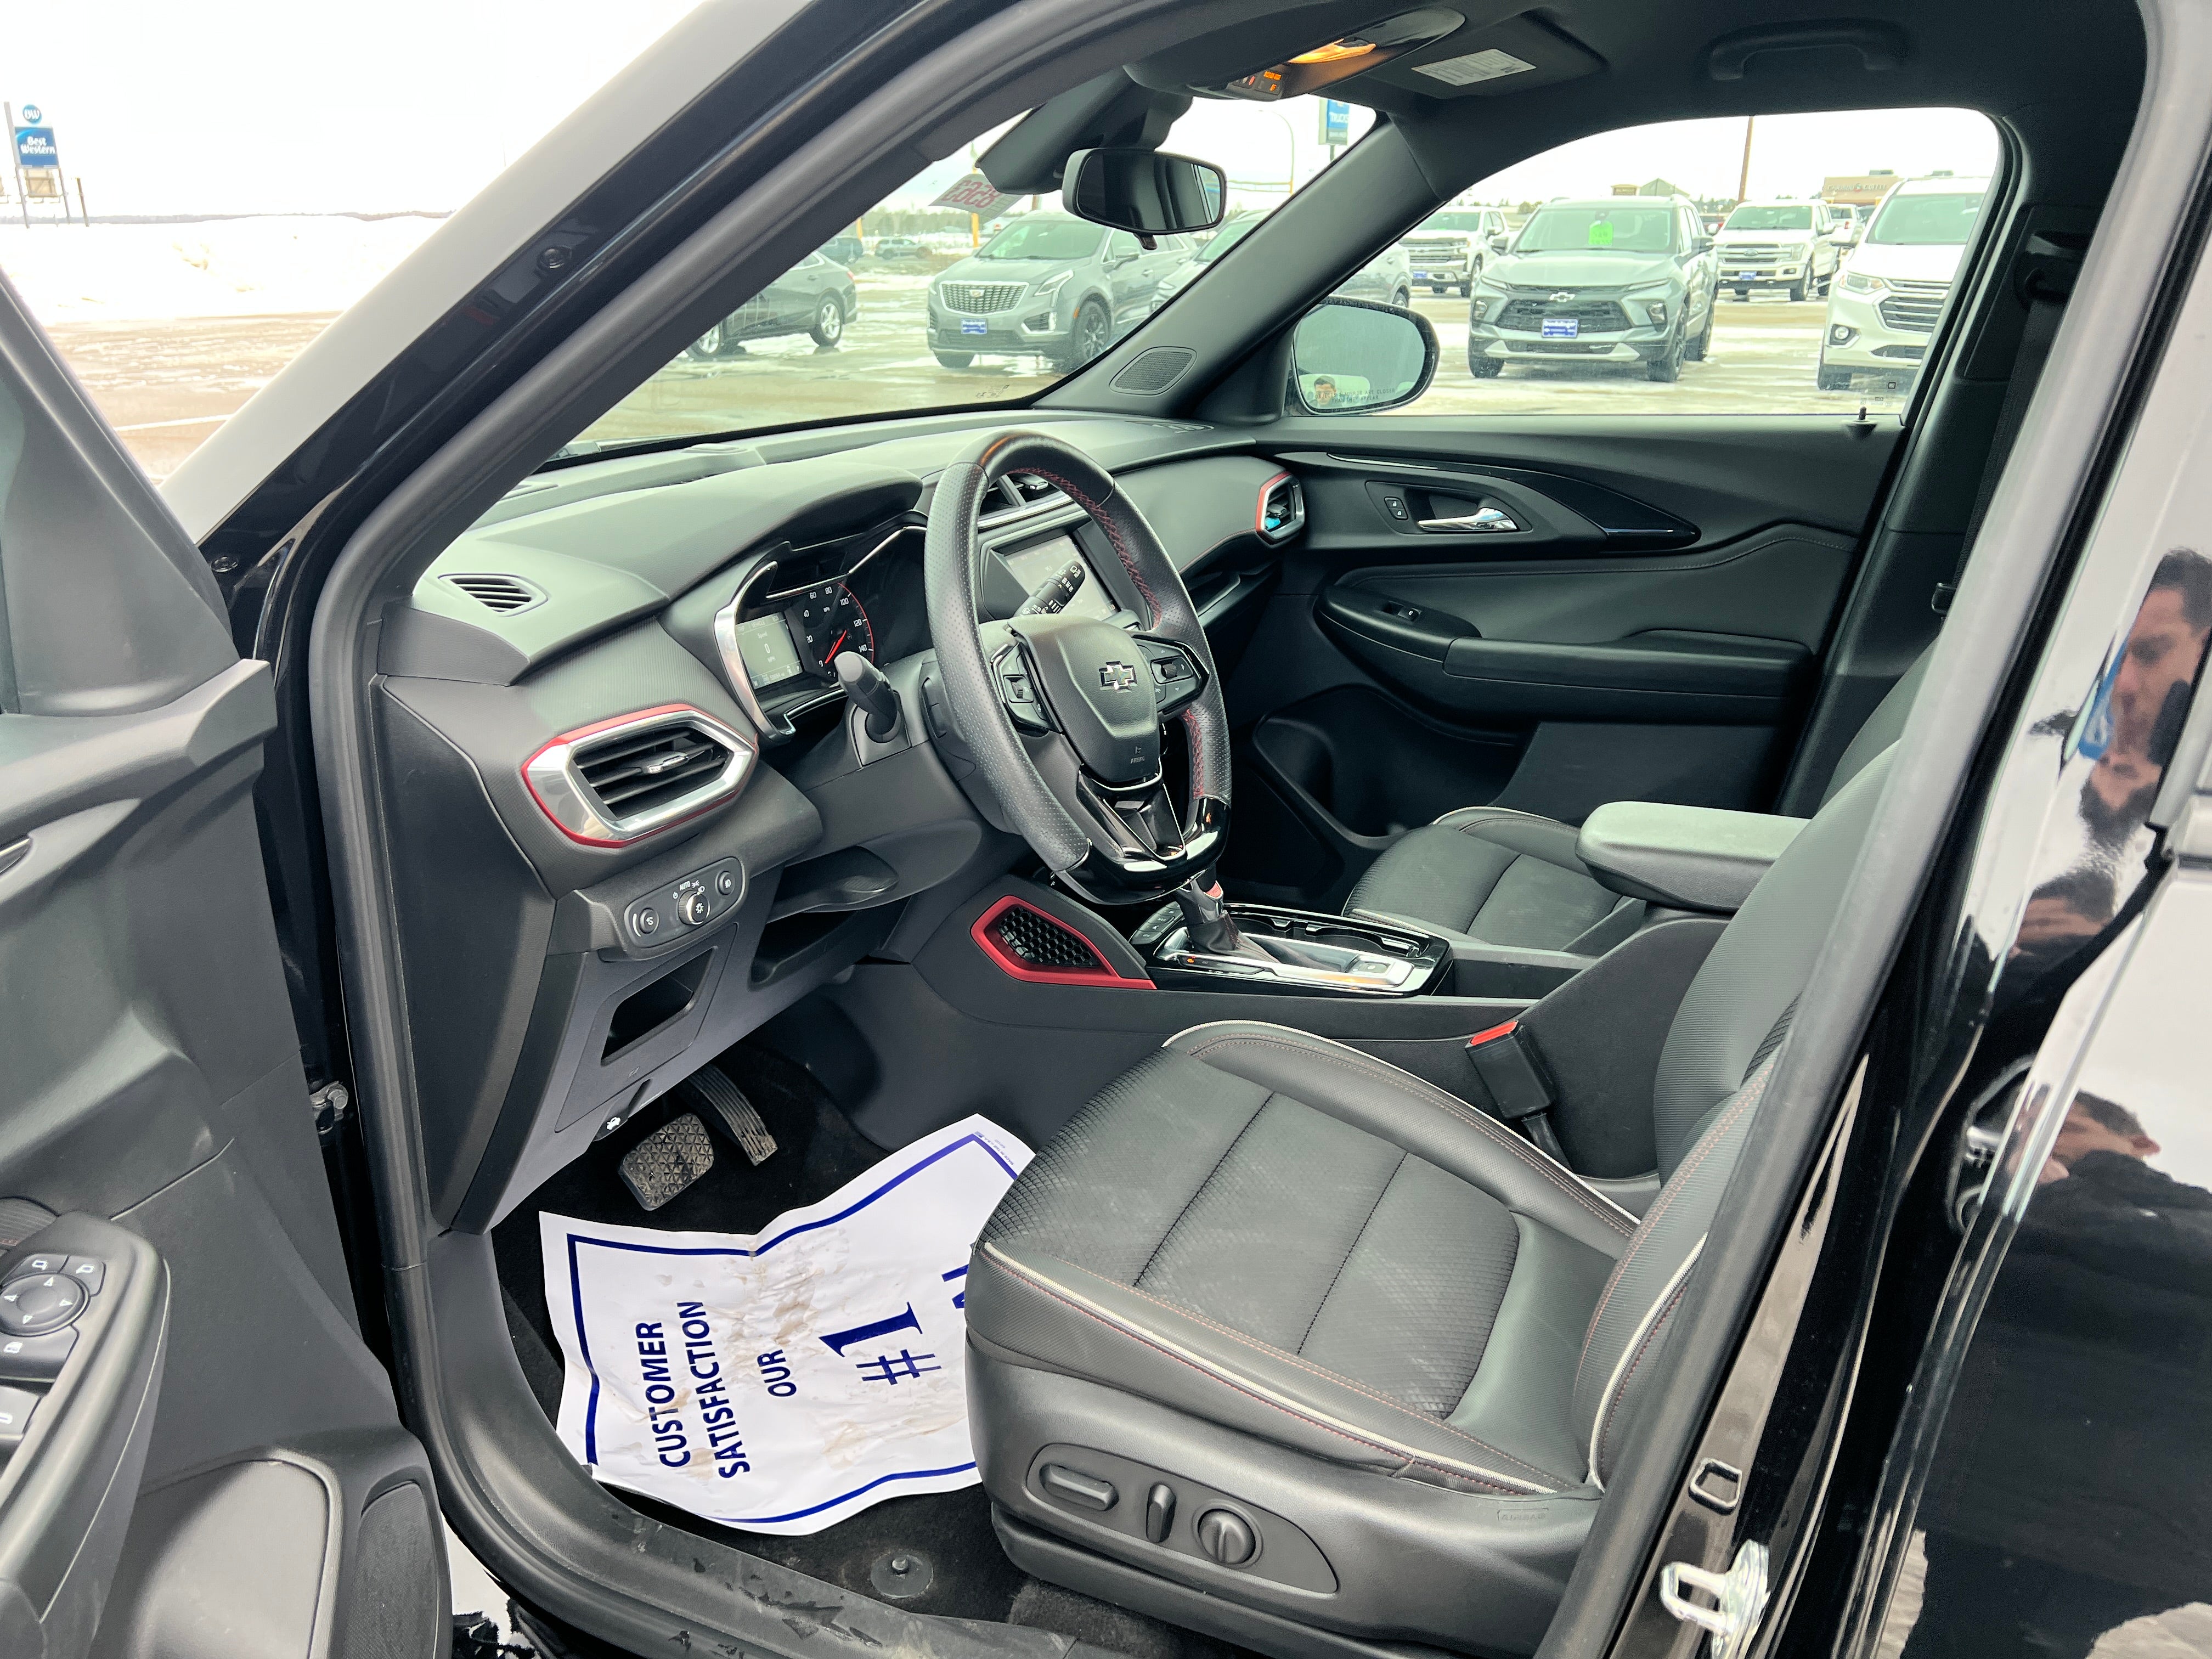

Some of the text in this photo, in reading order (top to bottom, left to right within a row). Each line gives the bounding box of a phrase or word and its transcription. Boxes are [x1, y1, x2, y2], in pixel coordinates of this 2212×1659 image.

[27, 136, 47, 146] Best
[20, 144, 55, 154] Western
[825, 586, 832, 595] 80
[840, 597, 849, 606] 100
[853, 618, 862, 627] 120
[764, 643, 770, 653] 0
[858, 644, 867, 653] 140
[679, 881, 691, 891] AUTO
[817, 1301, 942, 1386] #1
[757, 1349, 797, 1397] OUR
[635, 1322, 691, 1468] CUSTOMER
[676, 1302, 751, 1479] SATISFACTION
